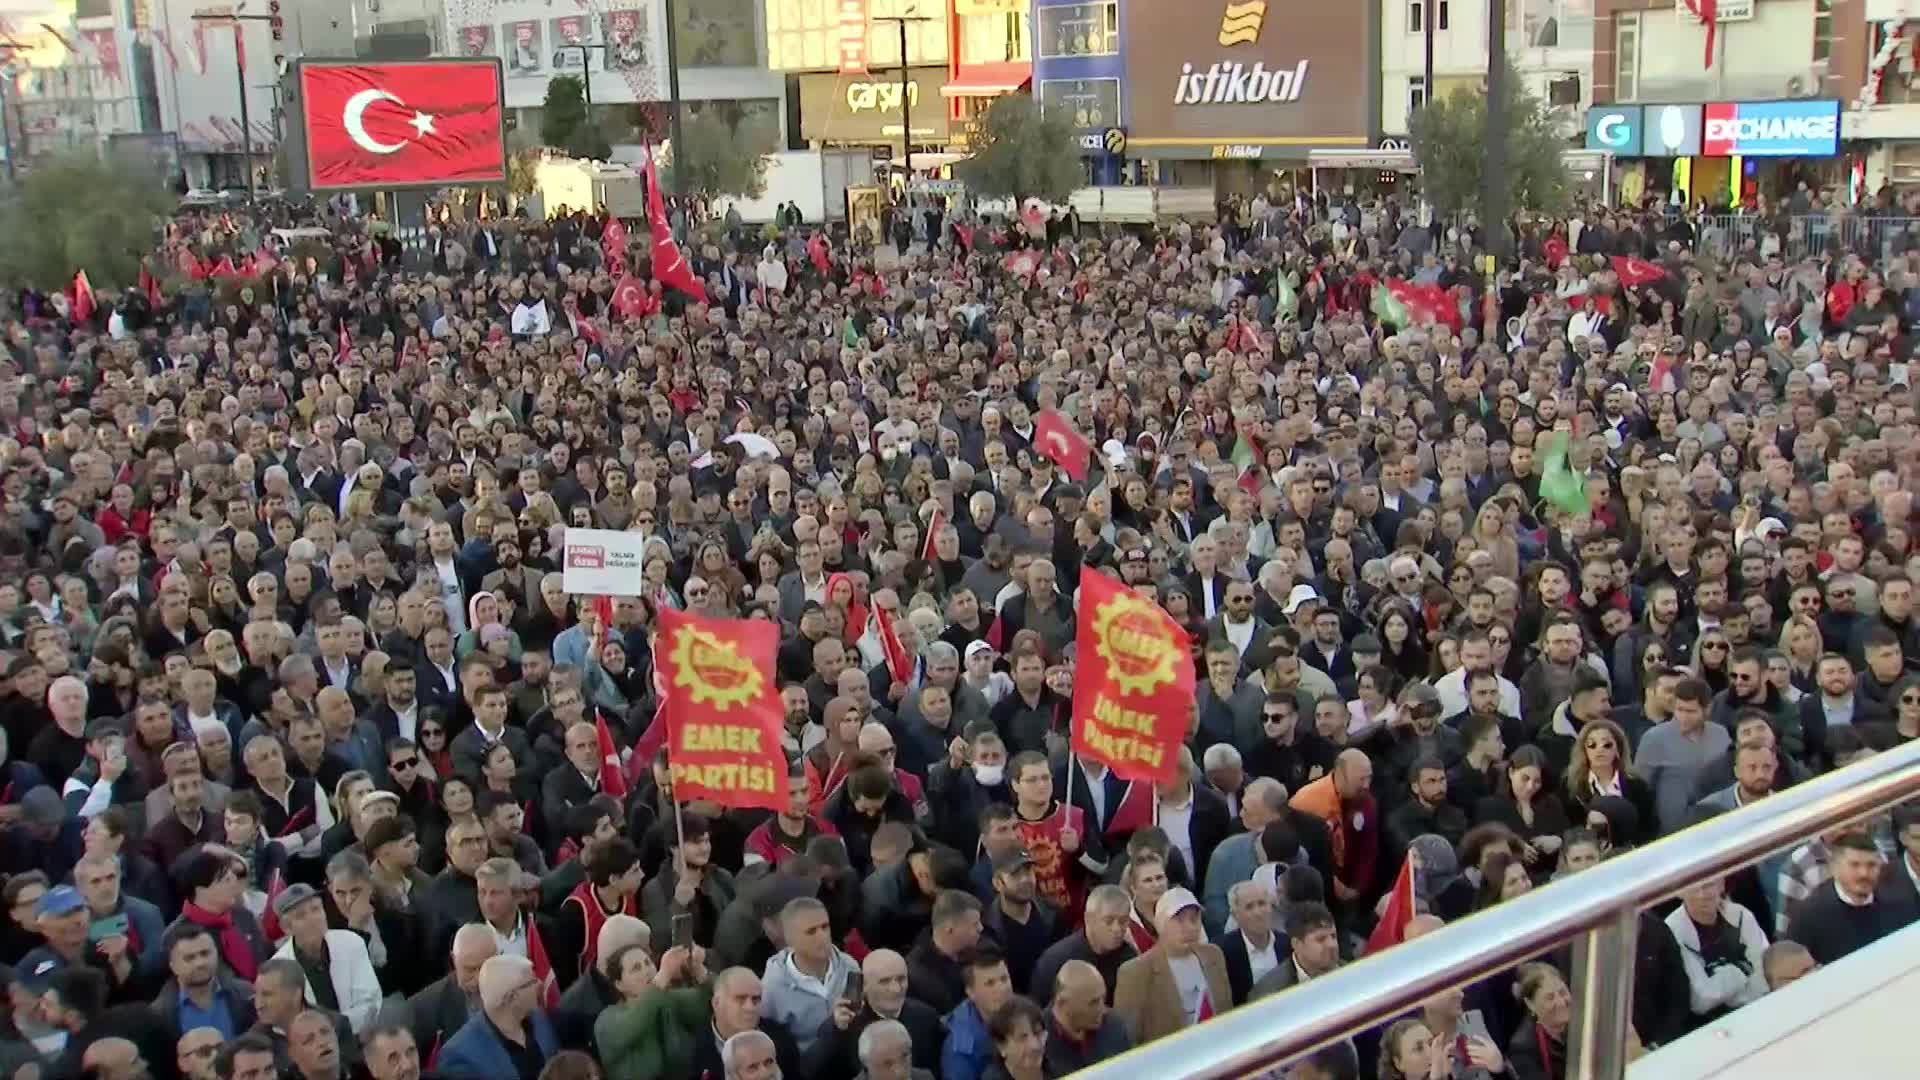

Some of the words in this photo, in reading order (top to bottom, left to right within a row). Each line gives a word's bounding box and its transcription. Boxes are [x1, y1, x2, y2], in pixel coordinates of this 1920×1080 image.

[1173, 59, 1310, 105] istikbal
[1595, 114, 1631, 146] G
[1705, 115, 1837, 141] EXCHANGE
[682, 723, 763, 753] EMEK
[669, 757, 775, 793] PARTİSİ
